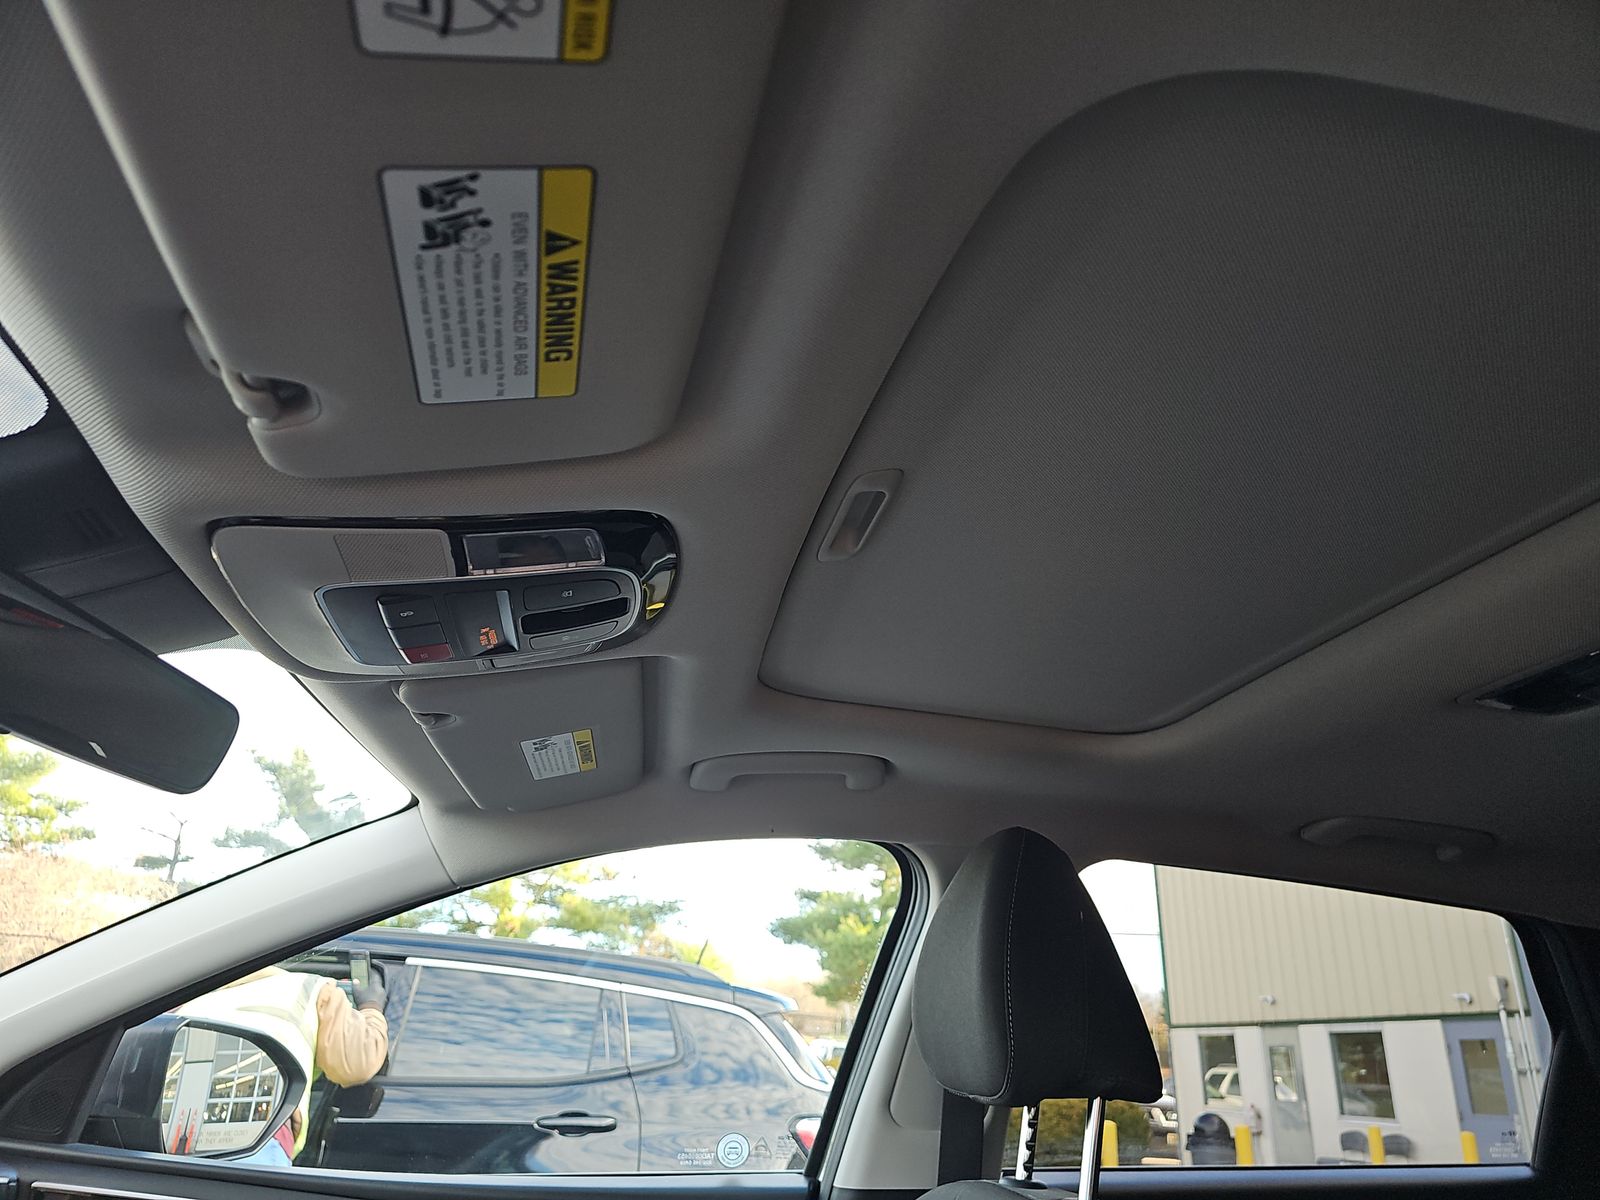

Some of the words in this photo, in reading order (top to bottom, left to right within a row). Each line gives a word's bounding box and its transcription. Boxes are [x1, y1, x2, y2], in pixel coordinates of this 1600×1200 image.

[511, 212, 529, 245] EVEN
[511, 248, 529, 278] WITH
[512, 280, 529, 334] ADVANCED
[544, 259, 580, 364] WARNING
[514, 335, 529, 351] AIR
[513, 353, 529, 376] BAGS
